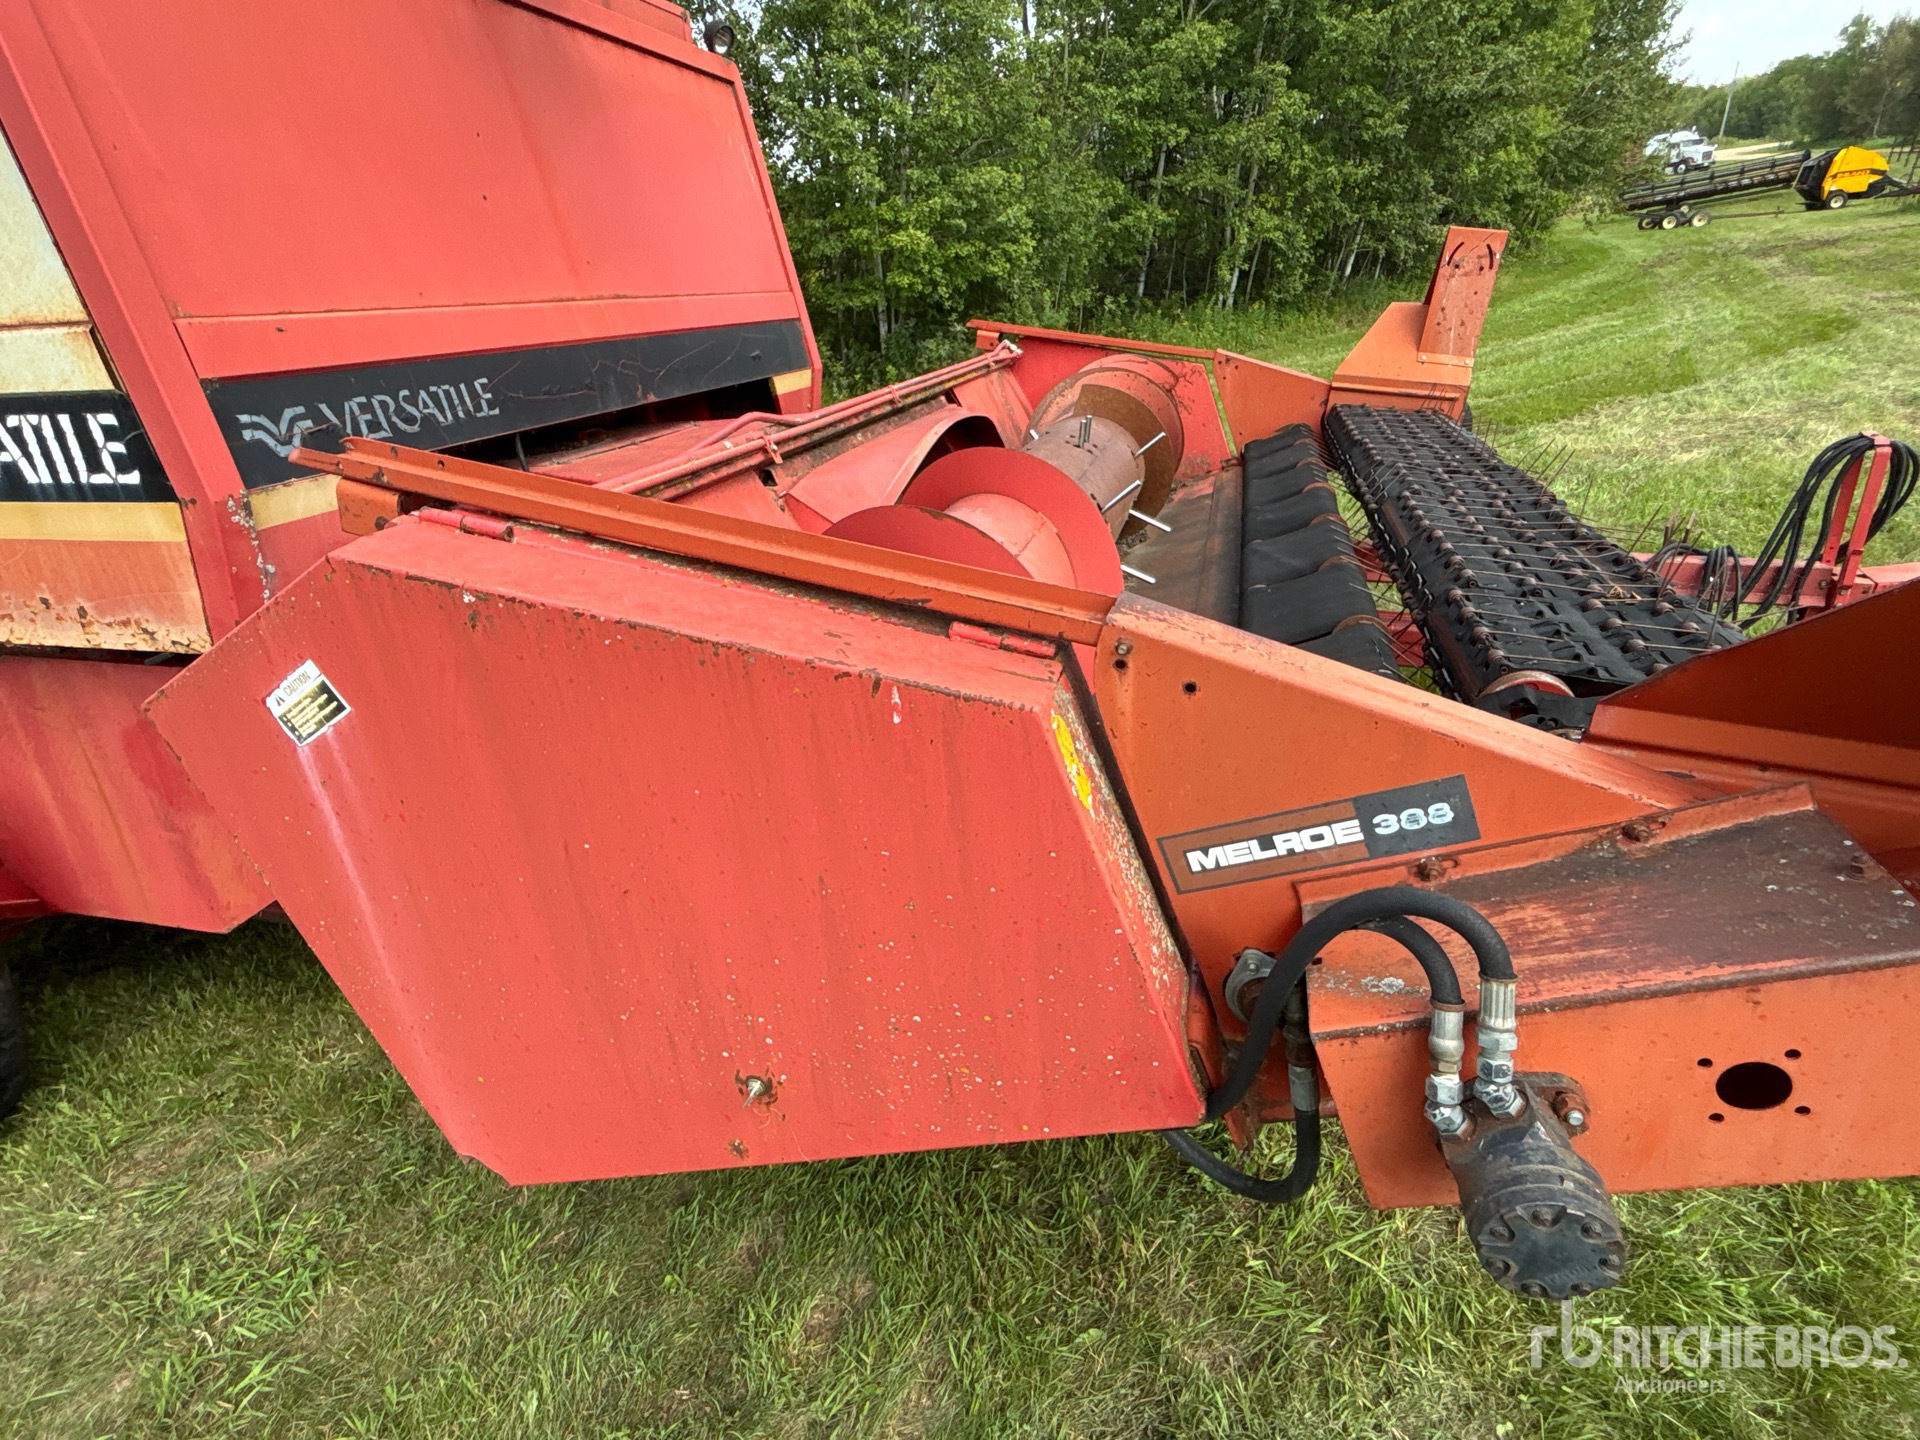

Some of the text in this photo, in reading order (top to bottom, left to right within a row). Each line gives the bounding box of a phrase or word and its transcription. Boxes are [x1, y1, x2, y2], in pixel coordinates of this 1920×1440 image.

[317, 378, 499, 438] VERSATILE
[283, 670, 311, 697] CAUTION
[1186, 802, 1455, 873] MELROE 388
